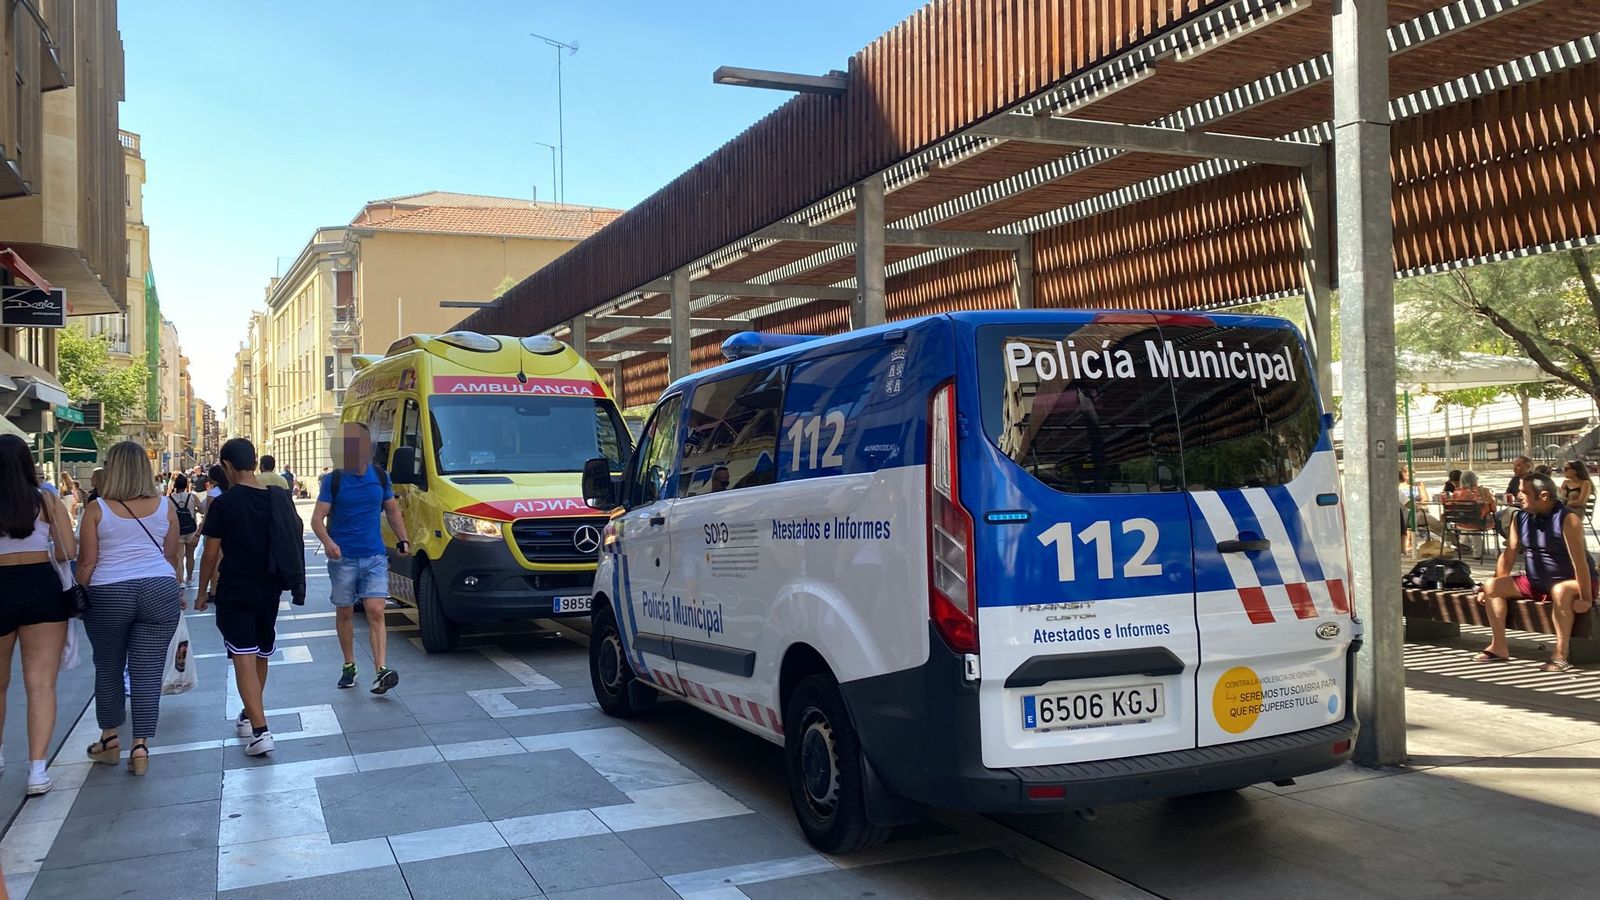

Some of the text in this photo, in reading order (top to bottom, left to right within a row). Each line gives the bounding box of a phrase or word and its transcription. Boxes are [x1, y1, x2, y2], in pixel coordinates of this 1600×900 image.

[1005, 339, 1297, 388] Policía Municipal
[450, 383, 594, 396] AMBULANCIA
[787, 410, 846, 472] 112
[772, 518, 820, 539] Atestados
[824, 521, 831, 540] e
[834, 516, 891, 540] Informes
[1036, 517, 1163, 582] 112
[562, 597, 592, 610] 9856
[642, 591, 723, 638] Policía Municipal
[1045, 613, 1097, 622] CUSTOM
[1033, 623, 1170, 644] Atestados e Informes
[1225, 679, 1251, 689] CONTRA
[1259, 673, 1288, 684] VIOLENCIA
[1240, 678, 1337, 703] SEREMOS TU SOMBRA PARA
[1040, 688, 1158, 723] 6506 KGJ
[1230, 695, 1319, 717] QUE RECUPERES TU LUZ
[1027, 715, 1034, 724] E
